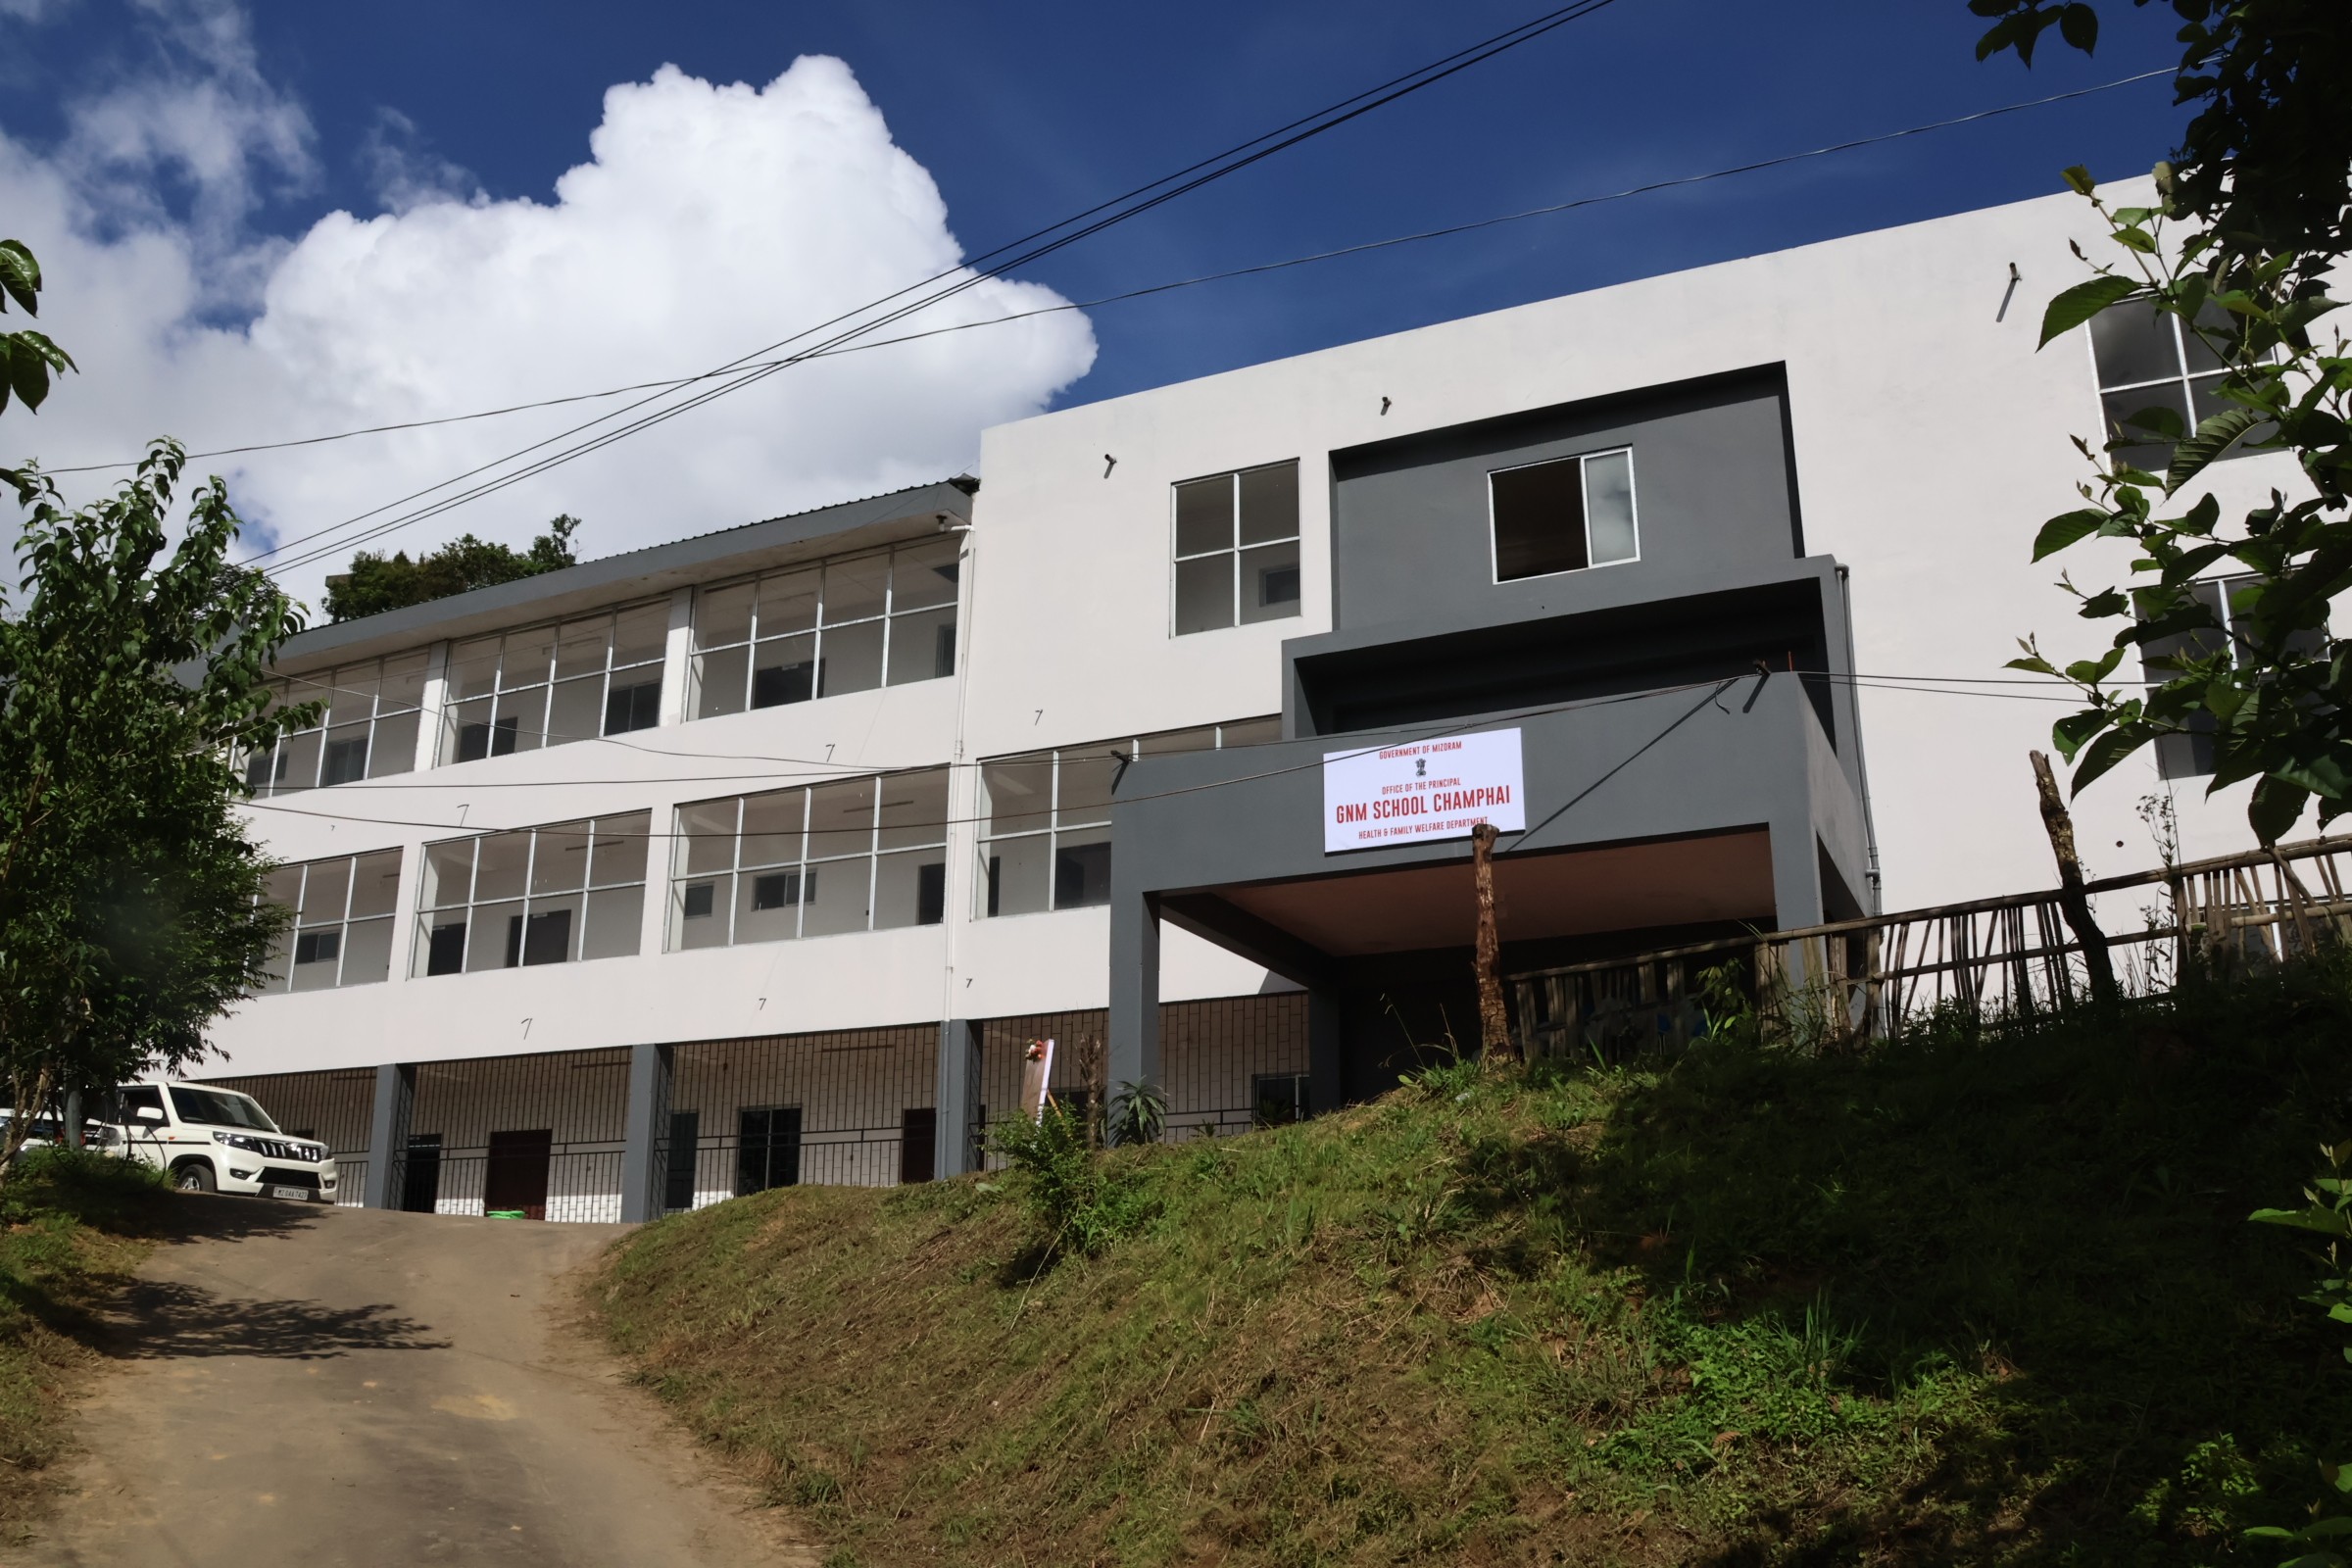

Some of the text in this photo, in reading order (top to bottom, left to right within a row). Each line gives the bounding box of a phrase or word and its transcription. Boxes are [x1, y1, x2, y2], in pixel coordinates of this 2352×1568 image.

[1379, 741, 1462, 760] GOVERNMENT OF MIZORAM
[1382, 777, 1461, 795] OFFICE OF THE PRINCIPAL
[1336, 785, 1510, 823] GNM SCHOOL CHAMPHAI
[1358, 816, 1488, 840] HEALTH & FAMILY WELFARE DEPARTMENT
